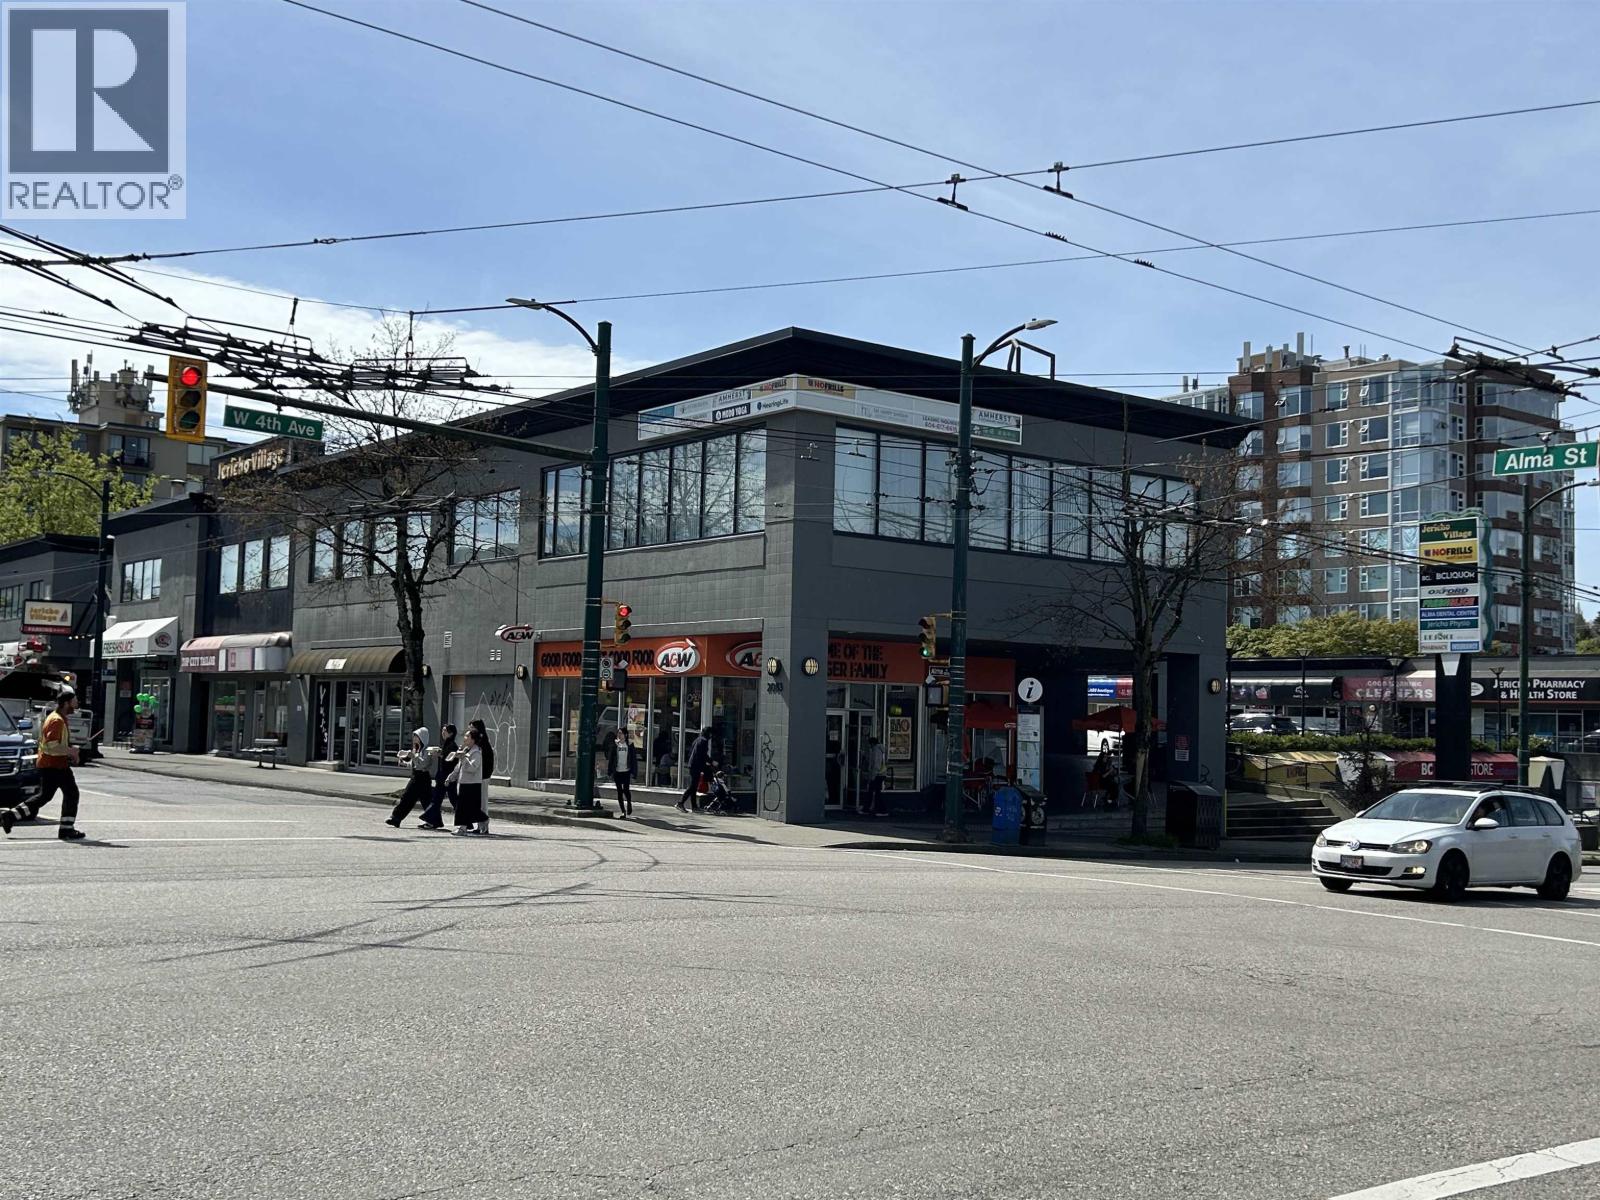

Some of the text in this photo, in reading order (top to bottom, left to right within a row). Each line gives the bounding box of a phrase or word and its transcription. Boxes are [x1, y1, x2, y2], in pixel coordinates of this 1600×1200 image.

[718, 391, 746, 402] AMHERST
[735, 405, 748, 416] YOGA
[978, 411, 1012, 422] AMHERST
[233, 410, 315, 437] W 4th Ave
[218, 448, 285, 480] Jericho Village
[1504, 447, 1587, 470] Alma St
[1421, 523, 1450, 533] Jericho
[1443, 530, 1472, 539] Village
[1432, 546, 1473, 556] NOFRILLS
[1428, 587, 1469, 595] OXFORD
[1456, 609, 1477, 617] CENTRE
[506, 630, 534, 640] A&W
[104, 640, 134, 654] FRESHSLICE
[844, 643, 859, 660] OF
[863, 644, 883, 661] THE
[541, 652, 560, 667] GOOD
[561, 652, 582, 666] FOOD
[632, 649, 655, 666] FOOD
[660, 651, 693, 668] A&W
[850, 662, 888, 679] FAMILY
[1533, 679, 1586, 688] PHARMACY
[1510, 689, 1545, 699] HELTH
[1547, 689, 1578, 699] STORE
[1421, 763, 1434, 775] BC
